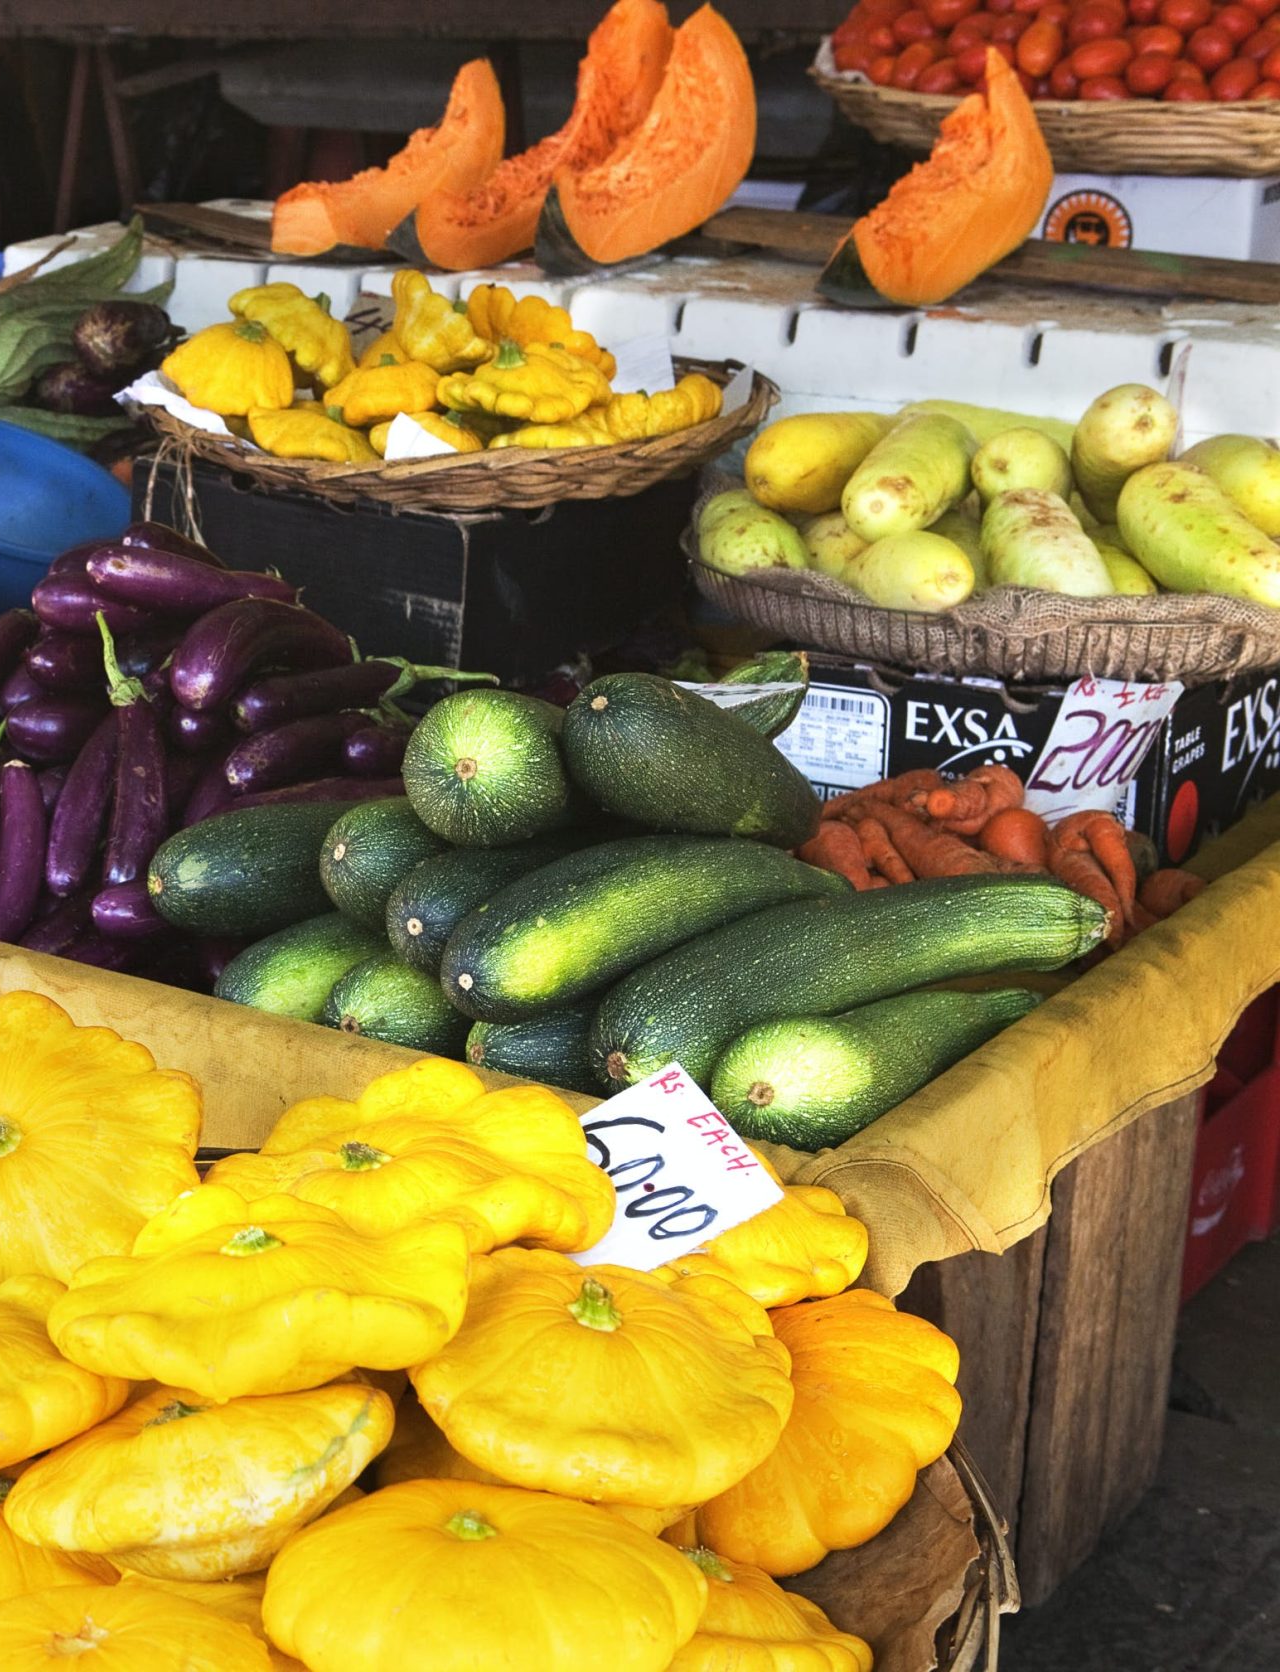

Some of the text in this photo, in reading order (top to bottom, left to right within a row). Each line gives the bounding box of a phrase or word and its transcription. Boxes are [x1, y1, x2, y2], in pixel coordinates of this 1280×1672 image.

[905, 700, 1025, 758] EXSA
[1175, 726, 1201, 753] TABLE
[1221, 678, 1280, 774] EXS
[1172, 742, 1205, 774] GRAPES
